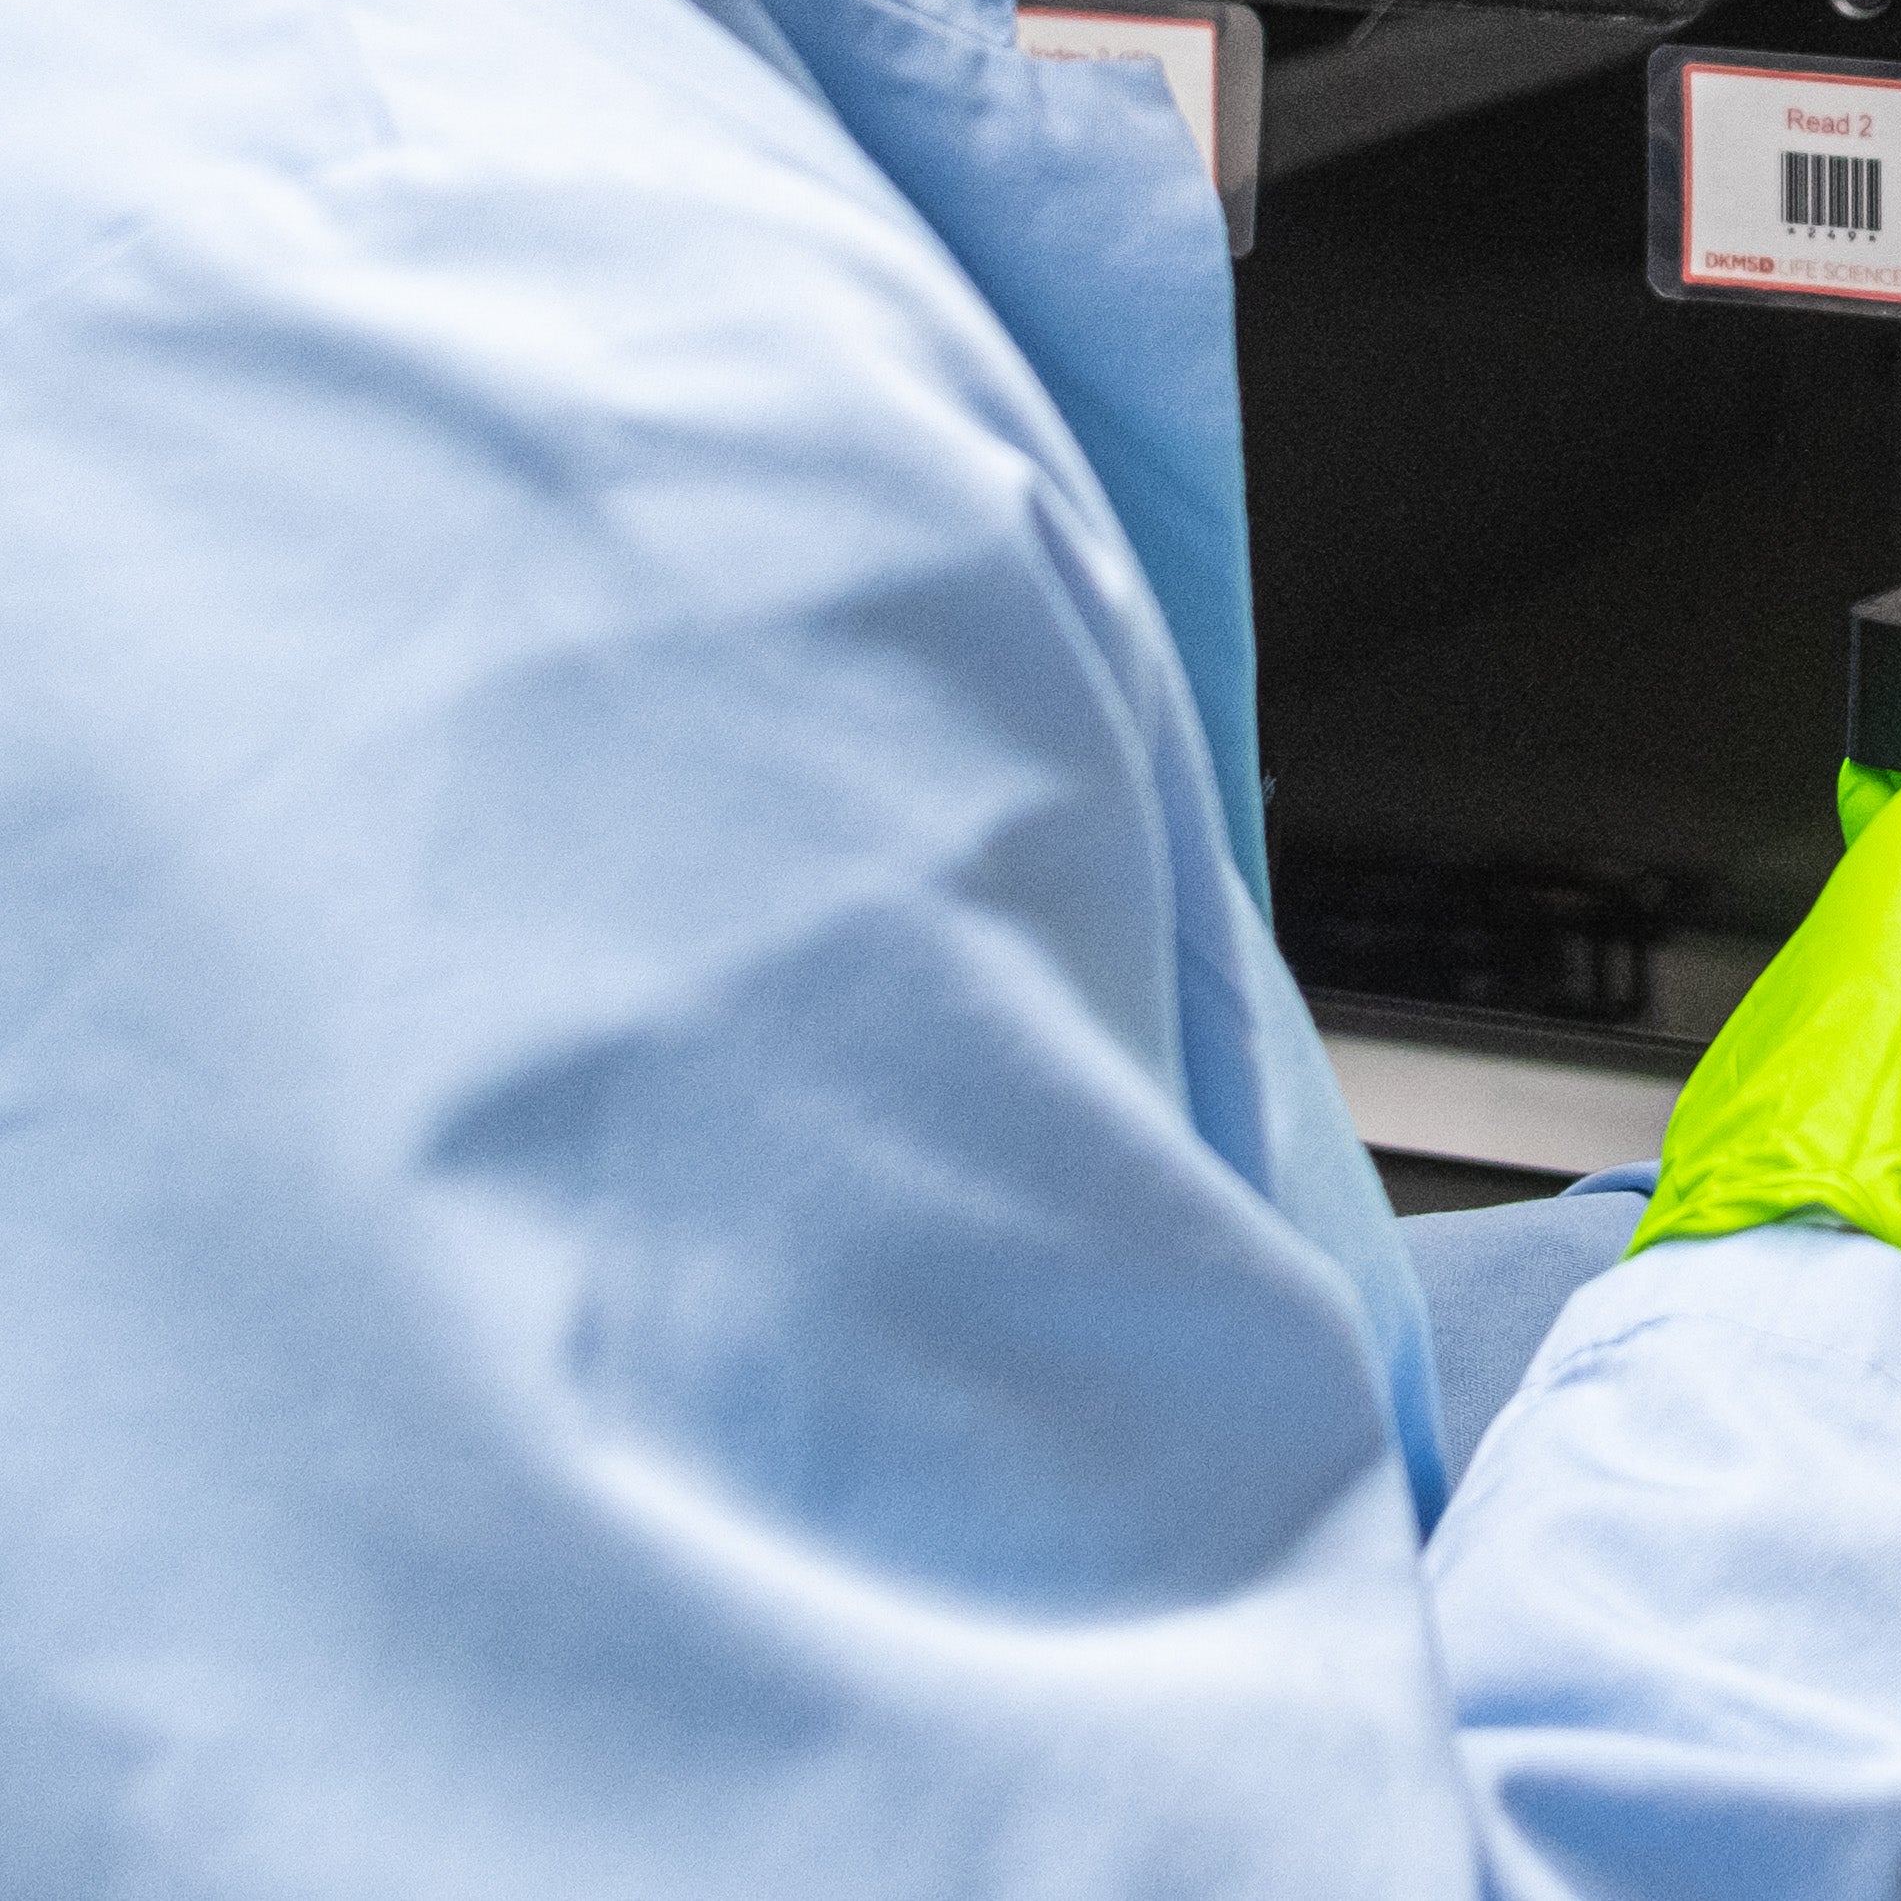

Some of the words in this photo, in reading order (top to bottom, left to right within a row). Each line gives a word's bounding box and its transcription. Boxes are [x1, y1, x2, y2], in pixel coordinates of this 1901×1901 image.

[1786, 108, 1850, 137] Read
[1859, 115, 1874, 139] 2
[1778, 259, 1818, 280] LIFE
